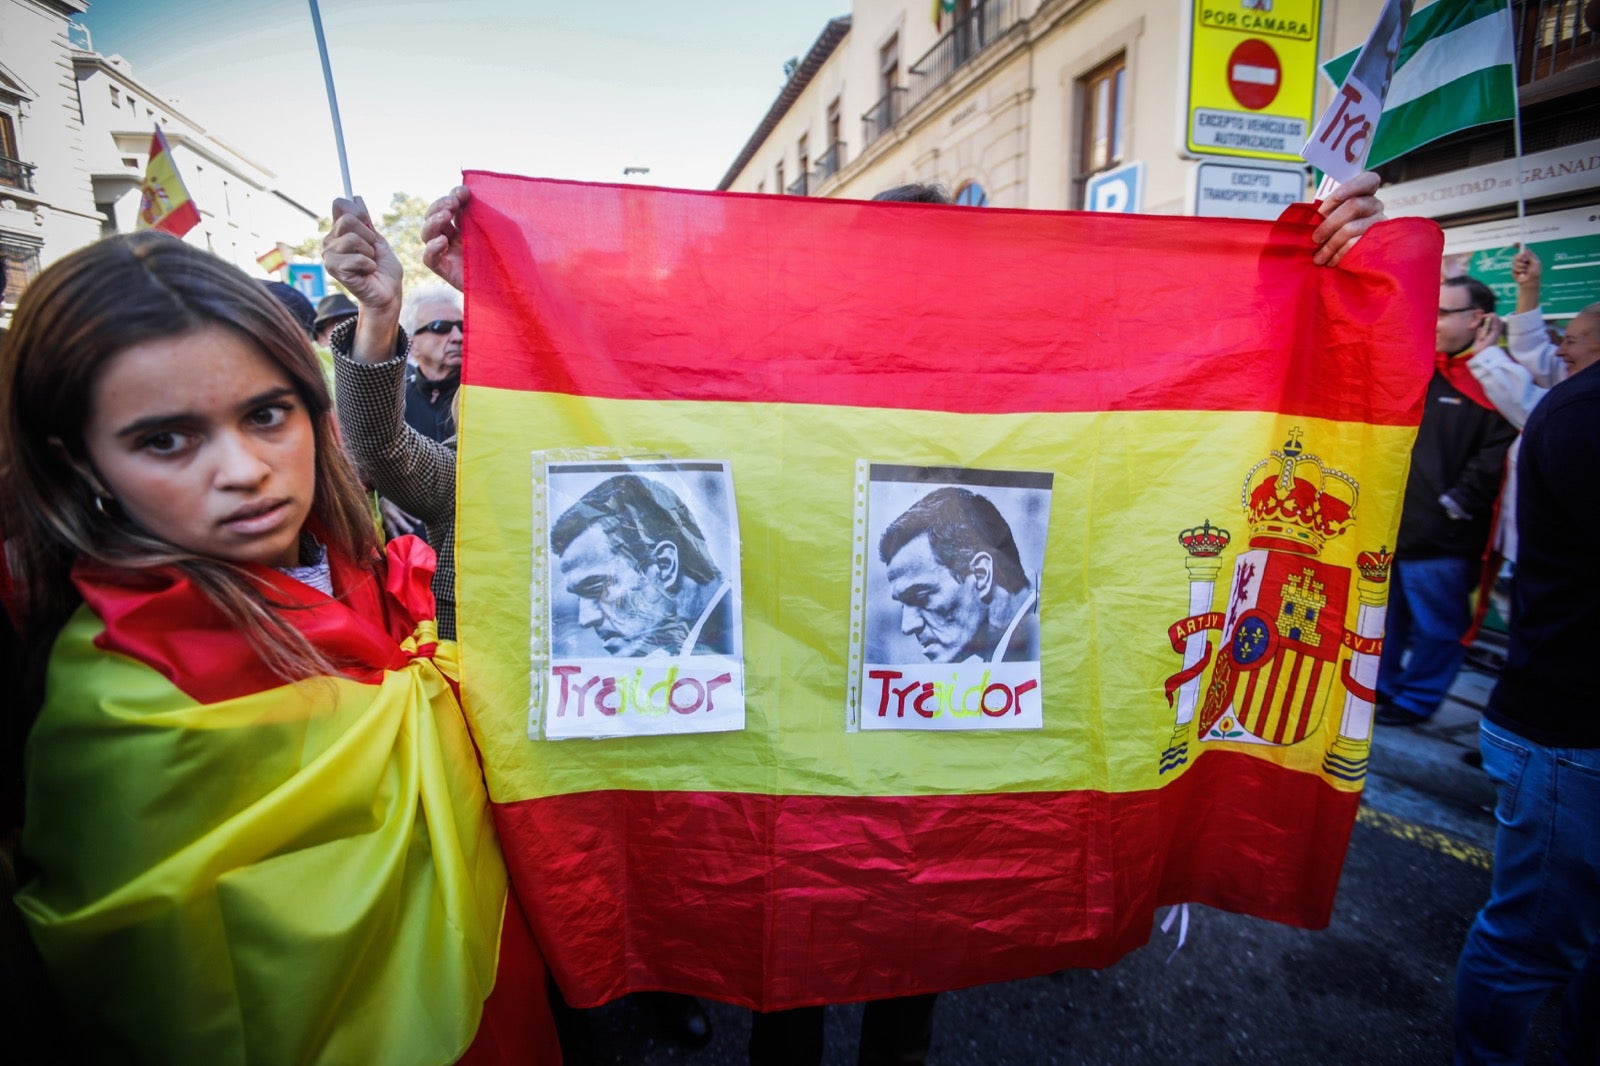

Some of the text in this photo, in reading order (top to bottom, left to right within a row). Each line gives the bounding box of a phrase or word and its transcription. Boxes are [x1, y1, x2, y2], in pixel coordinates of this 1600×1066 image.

[1203, 9, 1237, 25] POR
[1199, 113, 1244, 129] EXCEPTO
[1213, 131, 1285, 150] AUTORIZADOS
[1231, 172, 1271, 187] EXCEPTO
[1094, 179, 1129, 213] P
[1203, 187, 1258, 202] TRANSPORTE
[1430, 177, 1497, 202] CIUDAD
[552, 662, 731, 717] Traidor
[869, 670, 1037, 719] Traidor
